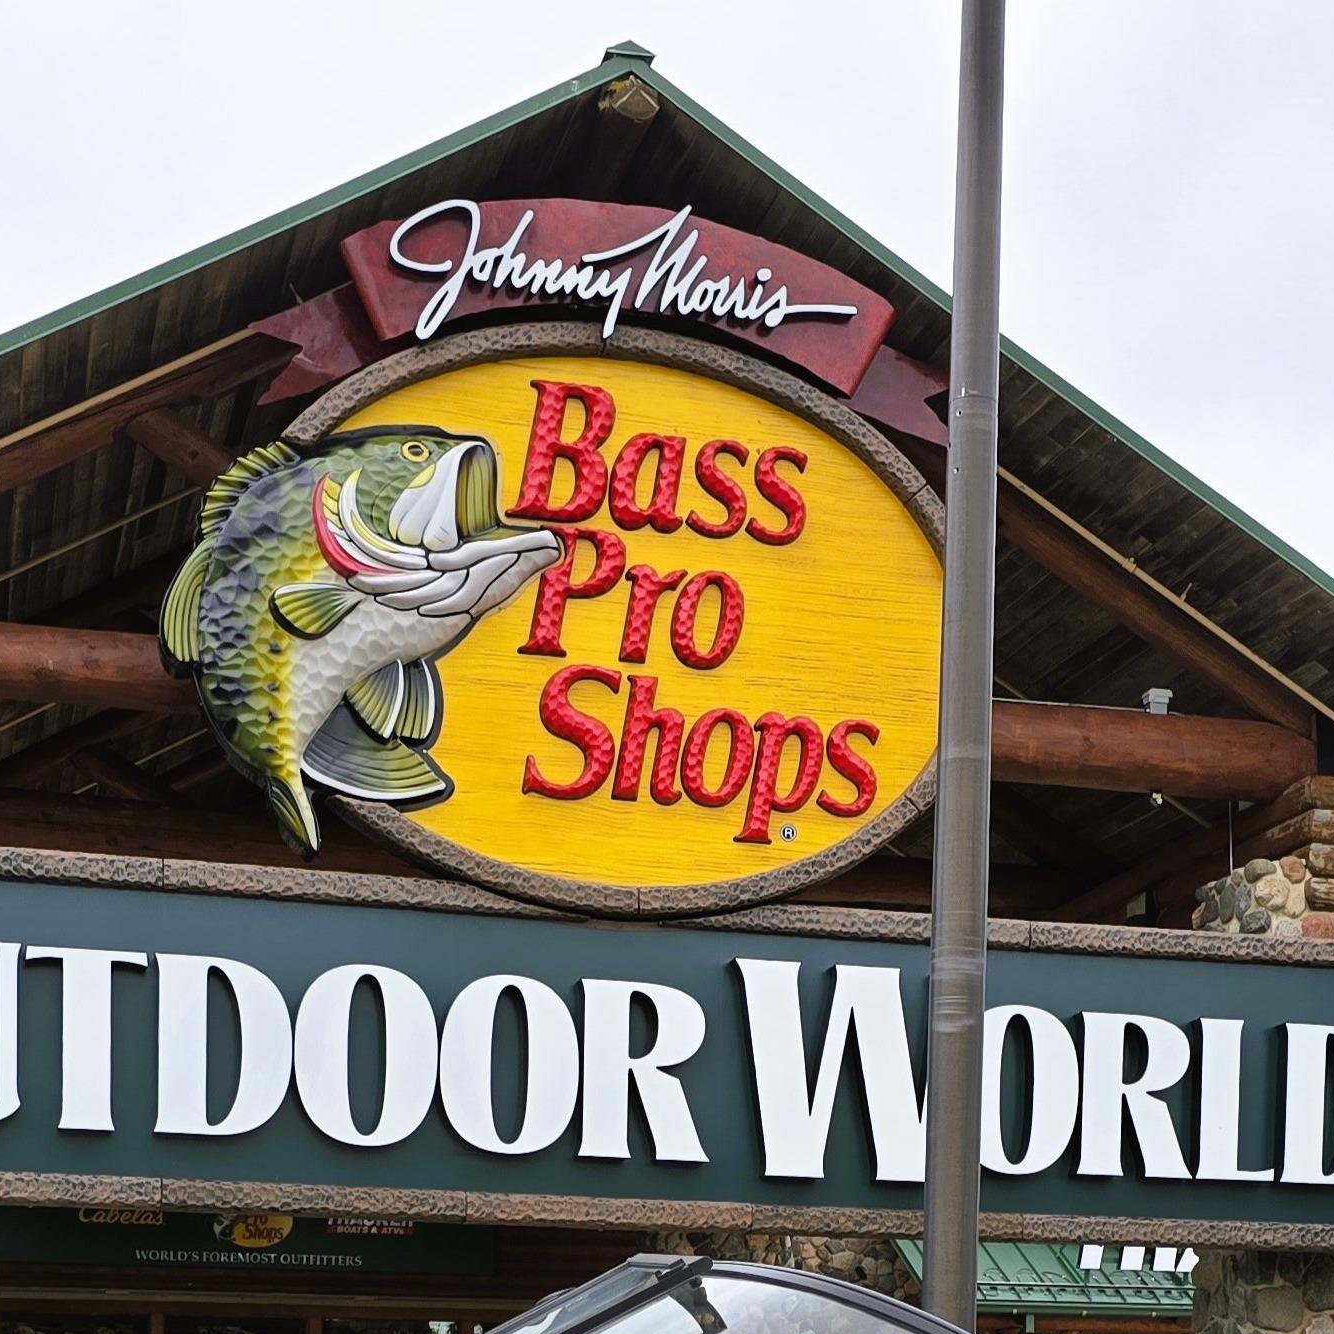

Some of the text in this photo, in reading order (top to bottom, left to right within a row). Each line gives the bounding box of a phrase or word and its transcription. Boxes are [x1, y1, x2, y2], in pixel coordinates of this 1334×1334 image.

[388, 199, 858, 341] Johnny Morris
[505, 379, 809, 547] Bass
[517, 526, 746, 671] Pro
[521, 664, 881, 845] Shops
[134, 1249, 364, 1266] WORLD'S FOREMOST OUTFITTERS
[242, 1223, 284, 1243] Shops
[336, 1225, 369, 1234] BOATS
